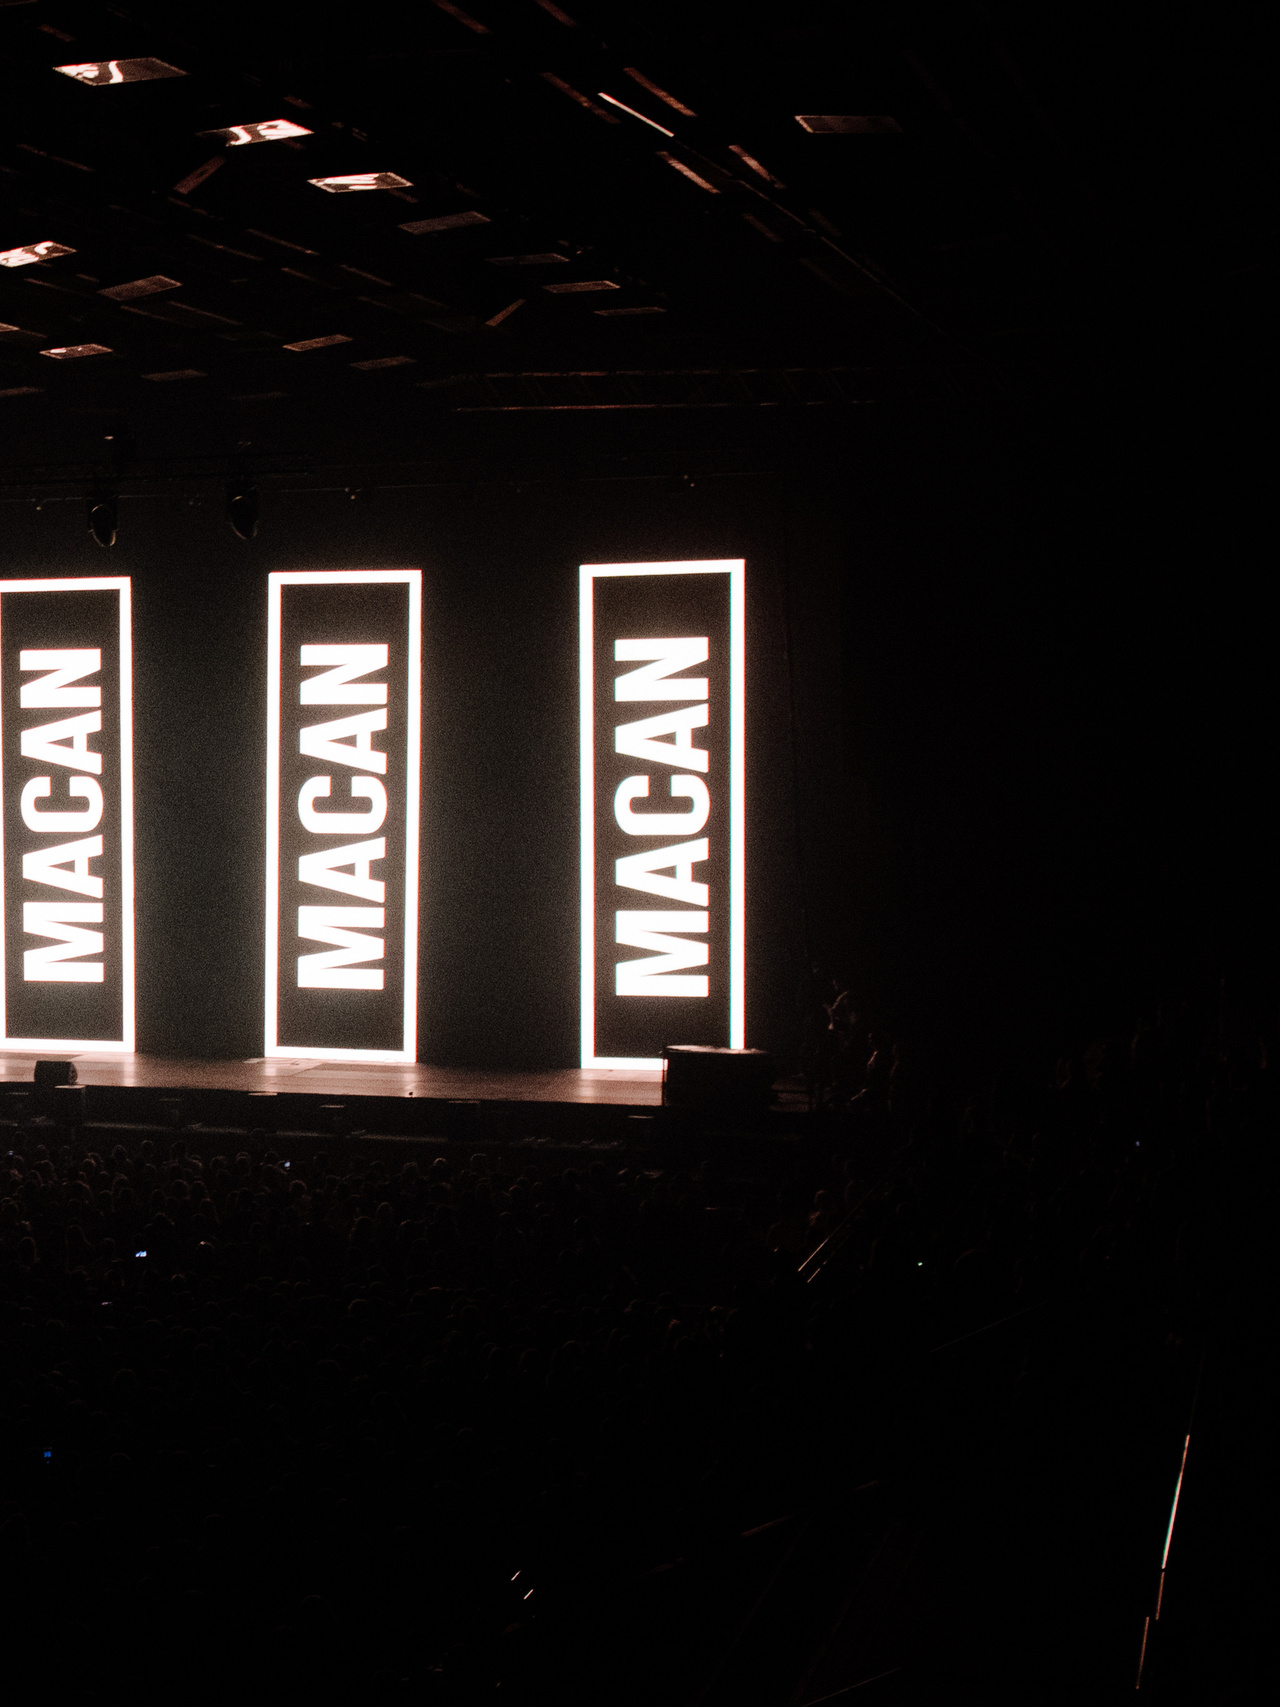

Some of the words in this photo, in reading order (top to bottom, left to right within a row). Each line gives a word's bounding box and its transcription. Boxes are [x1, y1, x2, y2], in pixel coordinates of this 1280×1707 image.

[19, 648, 106, 985] MACAN
[296, 643, 389, 992] MACAN
[613, 636, 710, 999] MACAN
